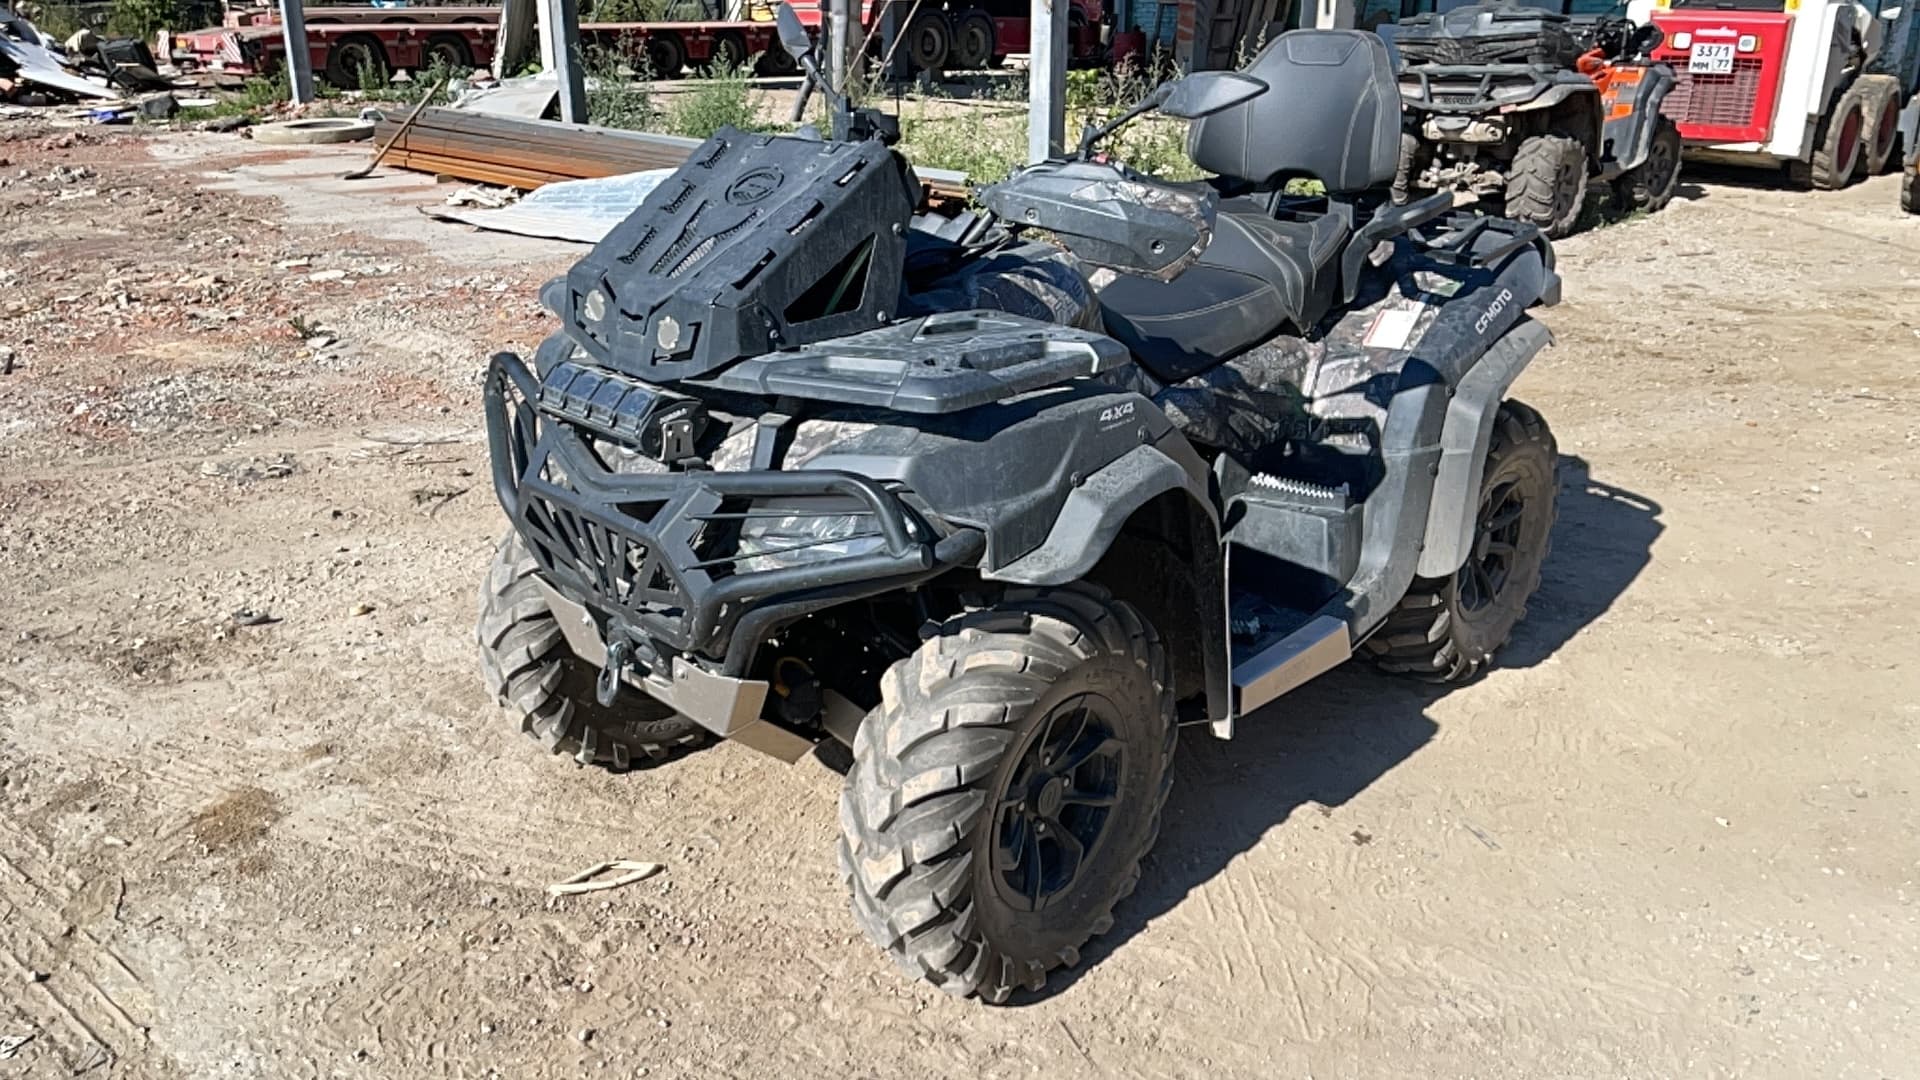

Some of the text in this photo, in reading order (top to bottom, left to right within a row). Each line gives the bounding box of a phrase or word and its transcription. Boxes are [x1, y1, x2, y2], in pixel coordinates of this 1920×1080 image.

[1697, 45, 1729, 58] 3371
[1716, 59, 1730, 68] 77
[1475, 288, 1513, 335] CFMOTO
